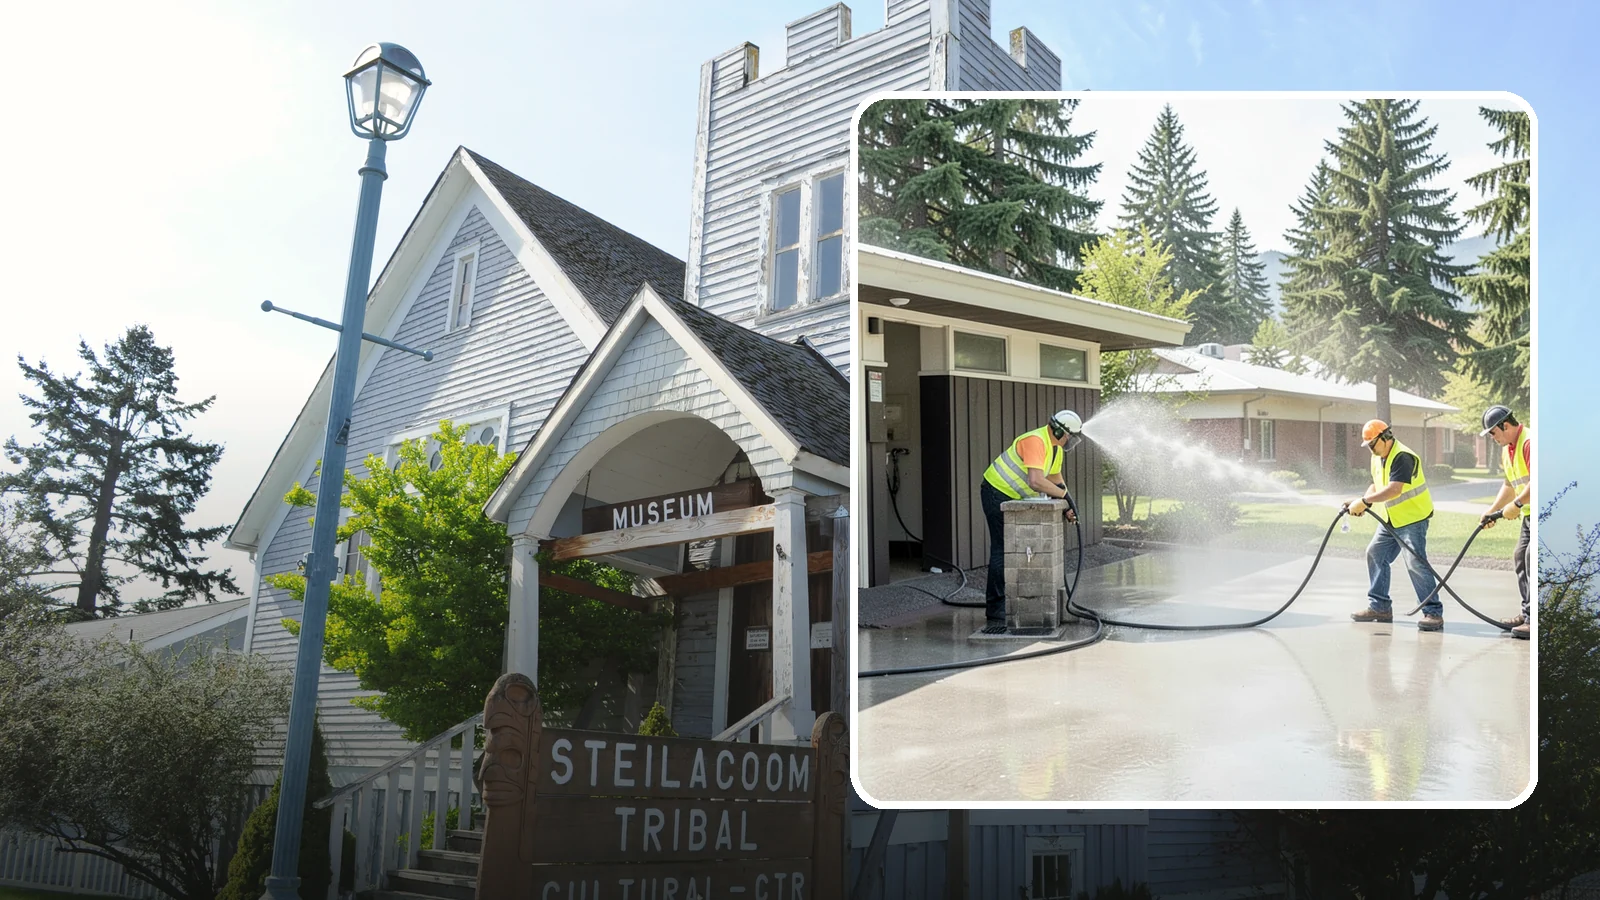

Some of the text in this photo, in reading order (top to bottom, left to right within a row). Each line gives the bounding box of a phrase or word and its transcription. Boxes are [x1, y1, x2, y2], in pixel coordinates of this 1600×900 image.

[612, 491, 713, 531] MUSEUM
[550, 738, 809, 792] STEILACOOM
[615, 806, 758, 851] TRIBAL
